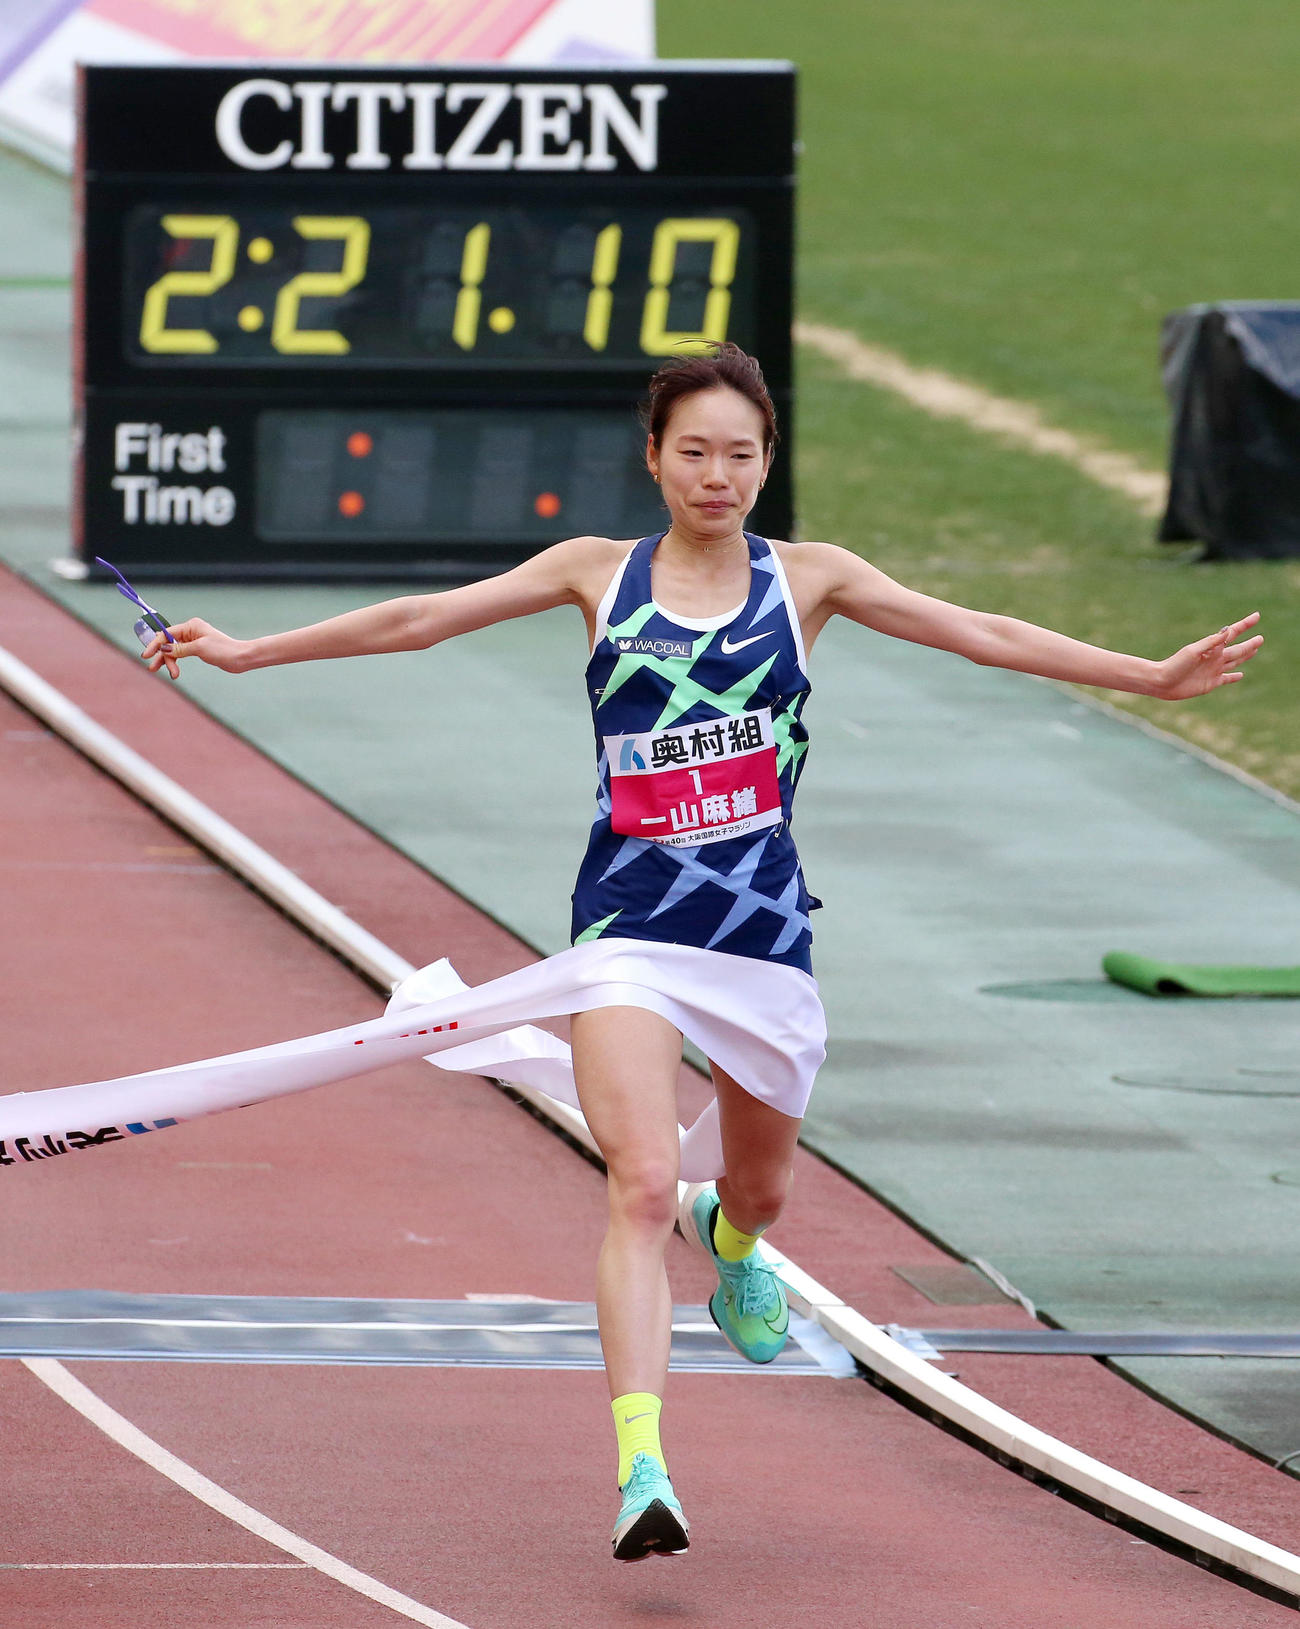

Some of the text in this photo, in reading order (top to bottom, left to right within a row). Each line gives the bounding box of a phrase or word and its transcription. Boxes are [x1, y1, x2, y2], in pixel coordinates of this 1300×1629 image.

[215, 79, 668, 171] CITIZEN
[114, 422, 226, 474] First
[111, 475, 236, 527] Time
[634, 639, 690, 656] WACOAL
[650, 714, 765, 769] 奥村組
[688, 769, 704, 796] 1
